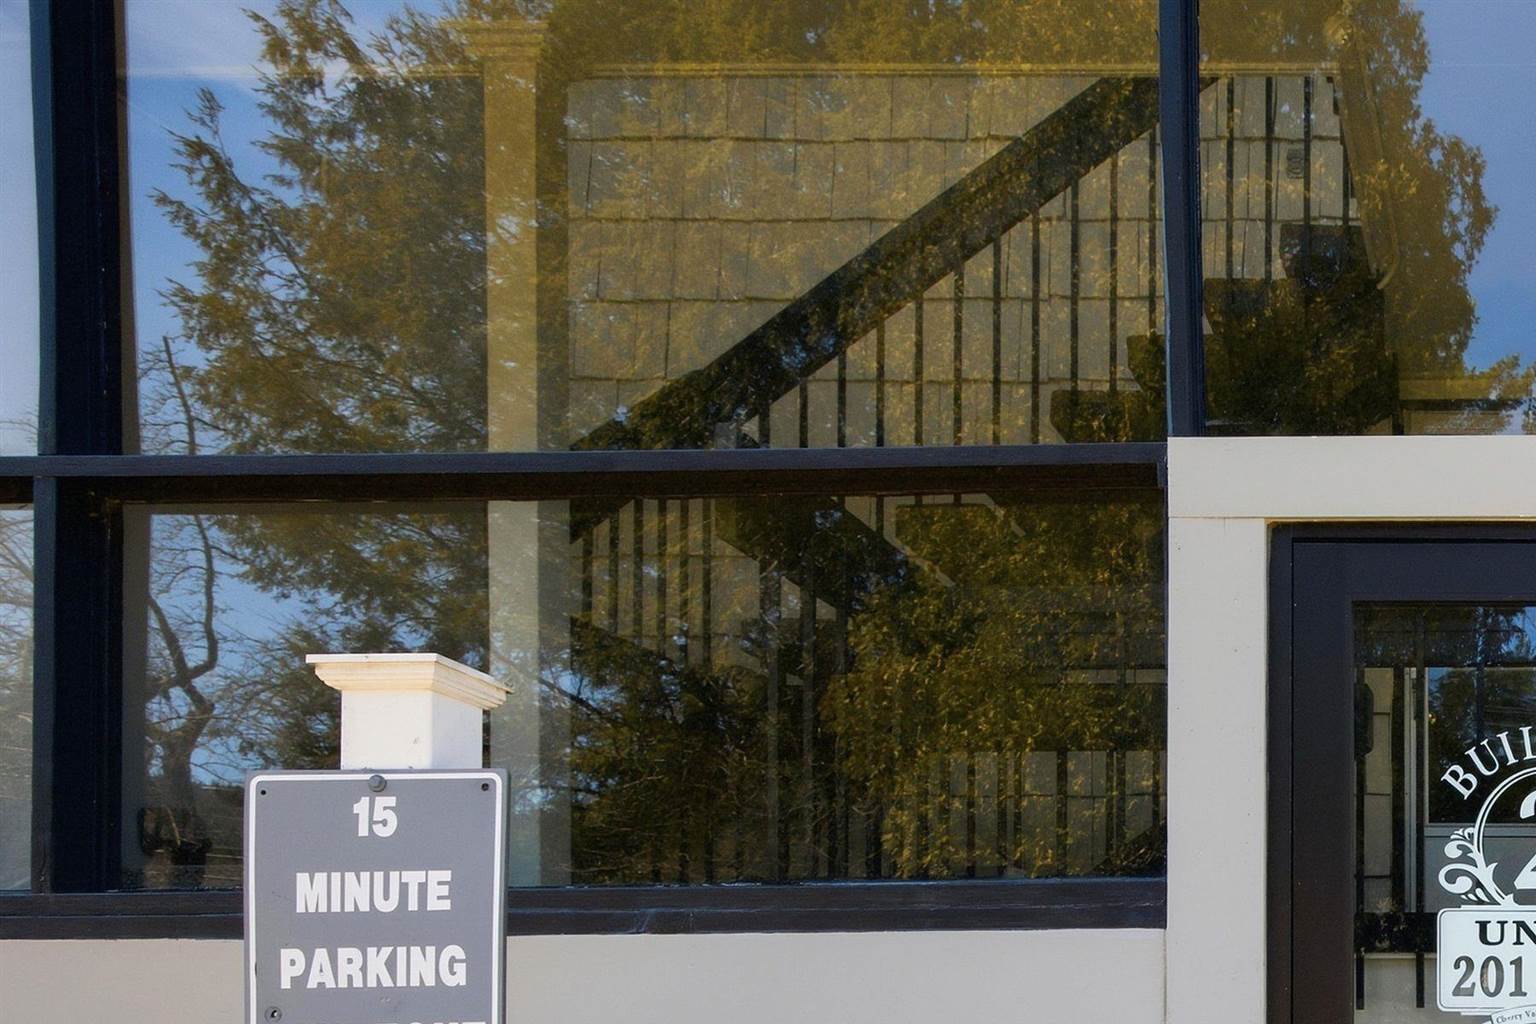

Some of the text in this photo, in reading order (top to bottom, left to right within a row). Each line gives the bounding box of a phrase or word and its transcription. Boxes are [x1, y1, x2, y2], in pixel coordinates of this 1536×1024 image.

[353, 796, 398, 837] 15
[296, 870, 451, 913] MINUTE
[280, 944, 467, 989] PARKING
